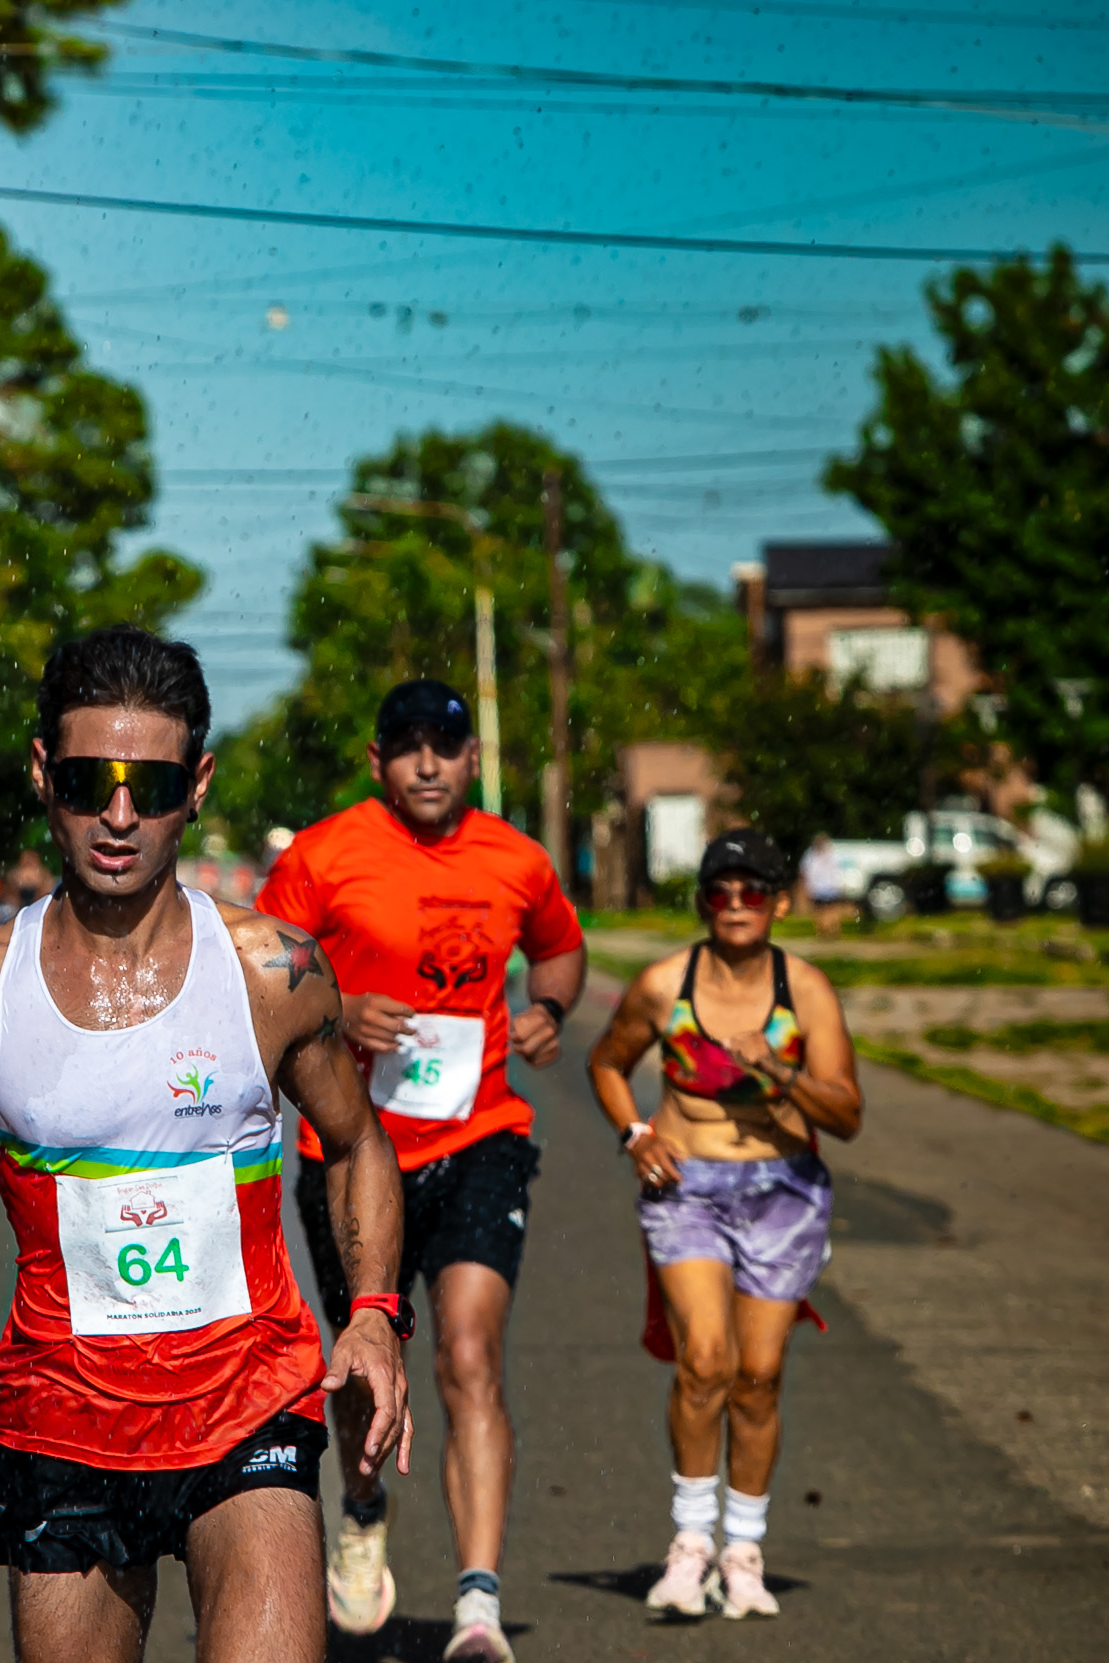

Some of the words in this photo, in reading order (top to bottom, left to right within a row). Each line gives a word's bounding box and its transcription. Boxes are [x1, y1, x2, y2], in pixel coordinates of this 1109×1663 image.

[170, 1051, 184, 1064] 10
[188, 1047, 217, 1062] años
[403, 1058, 442, 1085] 45
[117, 1237, 190, 1287] 64
[144, 1310, 184, 1319] SOLIDARIA
